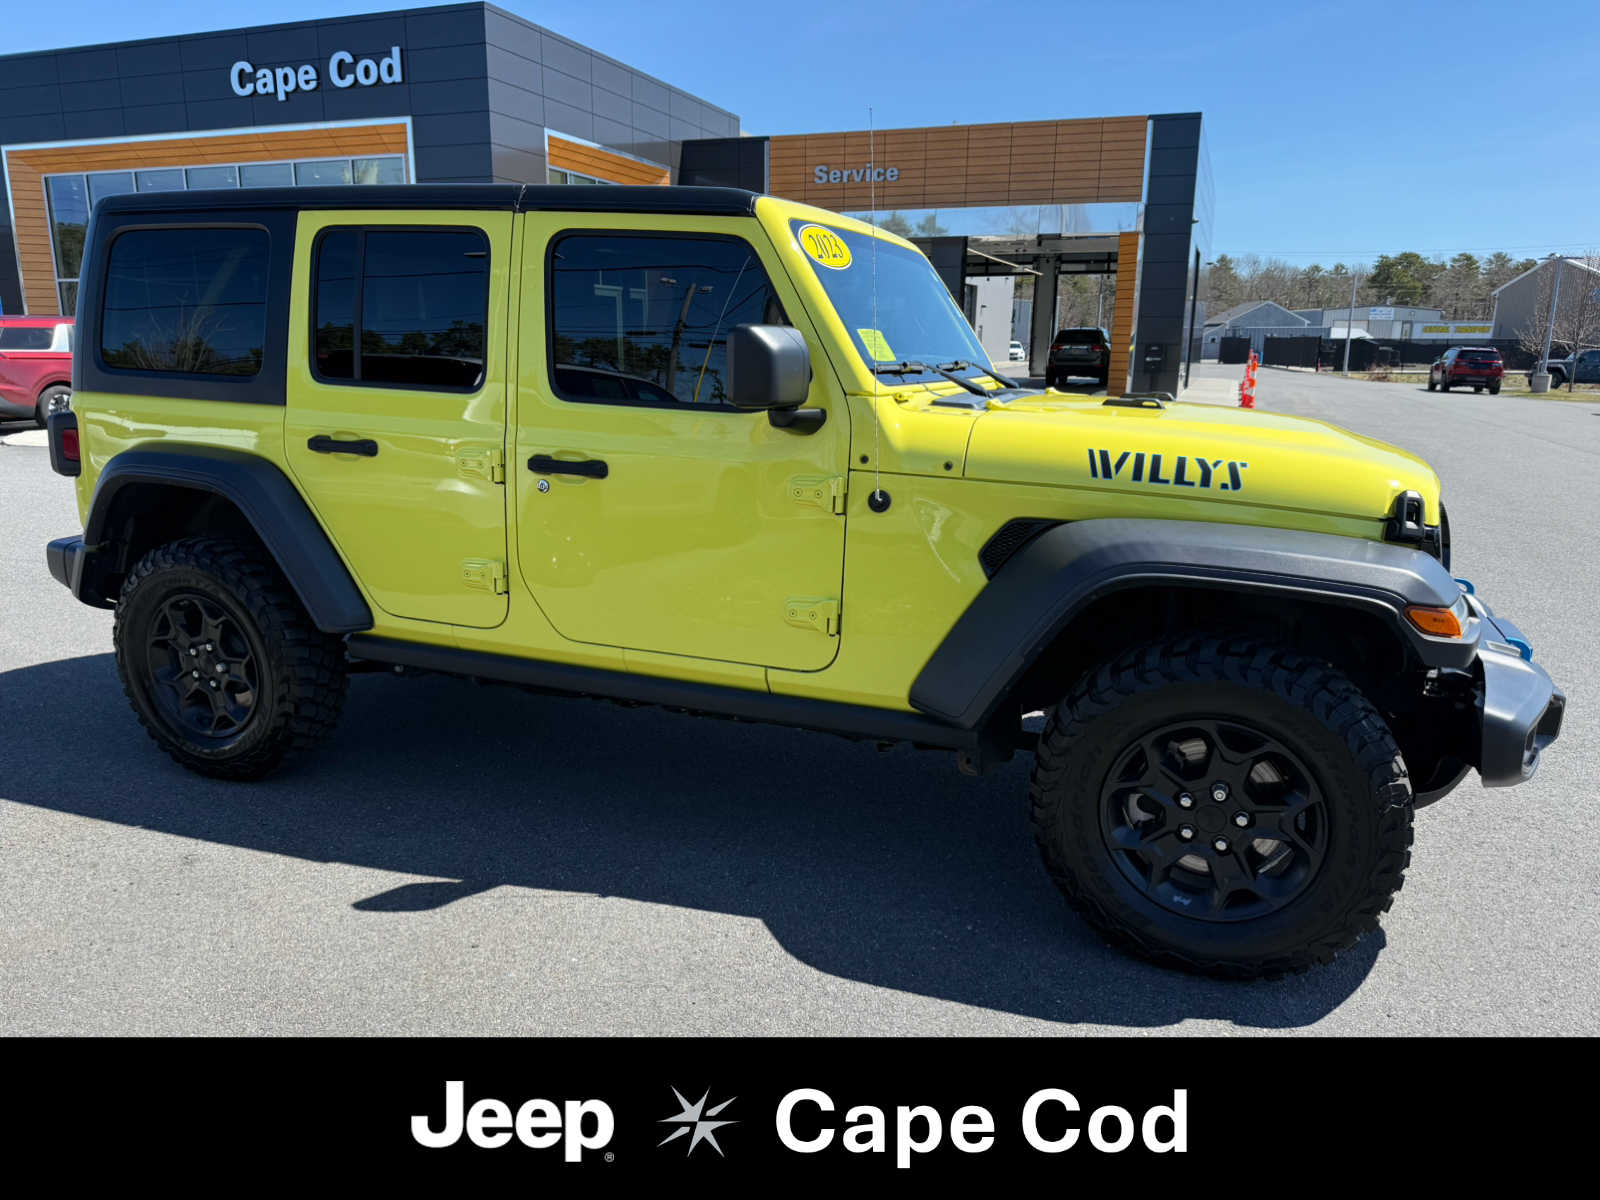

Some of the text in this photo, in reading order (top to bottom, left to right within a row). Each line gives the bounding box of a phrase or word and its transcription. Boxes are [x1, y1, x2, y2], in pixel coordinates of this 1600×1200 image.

[230, 46, 402, 101] Cape Cod
[814, 163, 899, 184] Service
[808, 233, 844, 259] 2023
[1088, 448, 1248, 491] WILLYS
